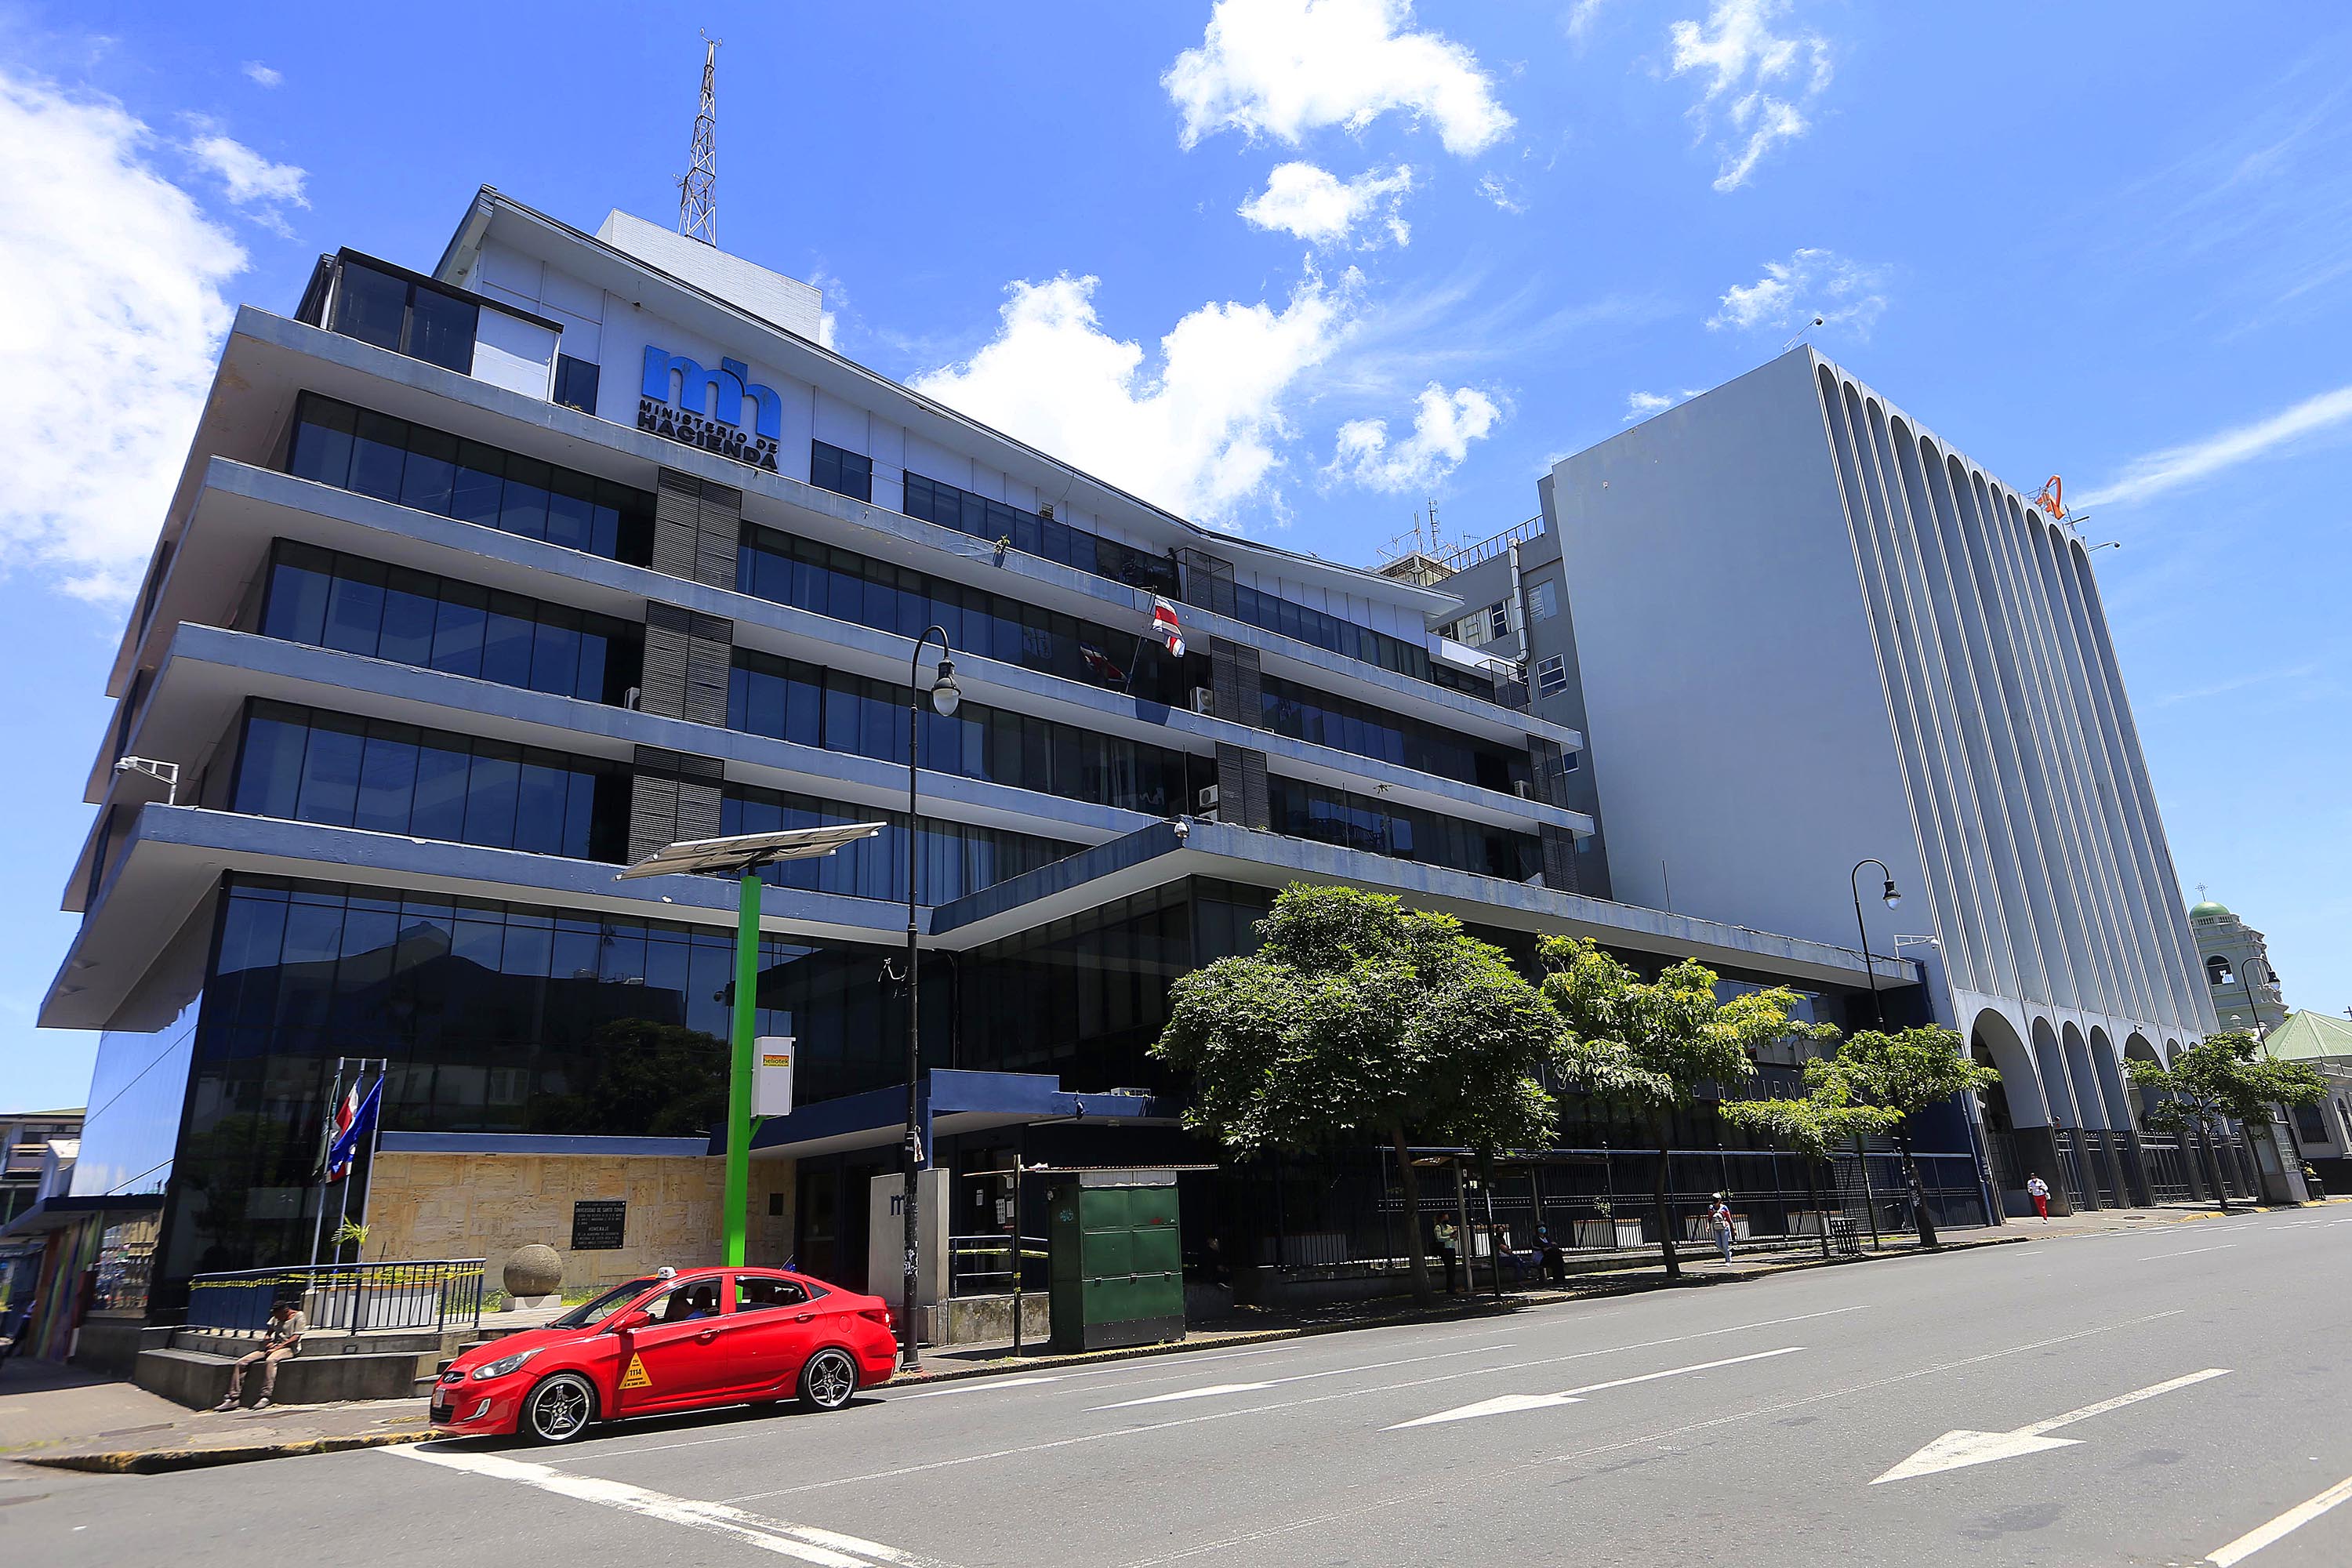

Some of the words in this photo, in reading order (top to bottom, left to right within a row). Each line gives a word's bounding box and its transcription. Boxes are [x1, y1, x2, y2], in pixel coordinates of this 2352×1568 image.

[637, 411, 778, 470] HACIENDA
[639, 399, 748, 444] MINISTERIO
[756, 438, 779, 454] DE
[763, 1055, 789, 1064] heliotek
